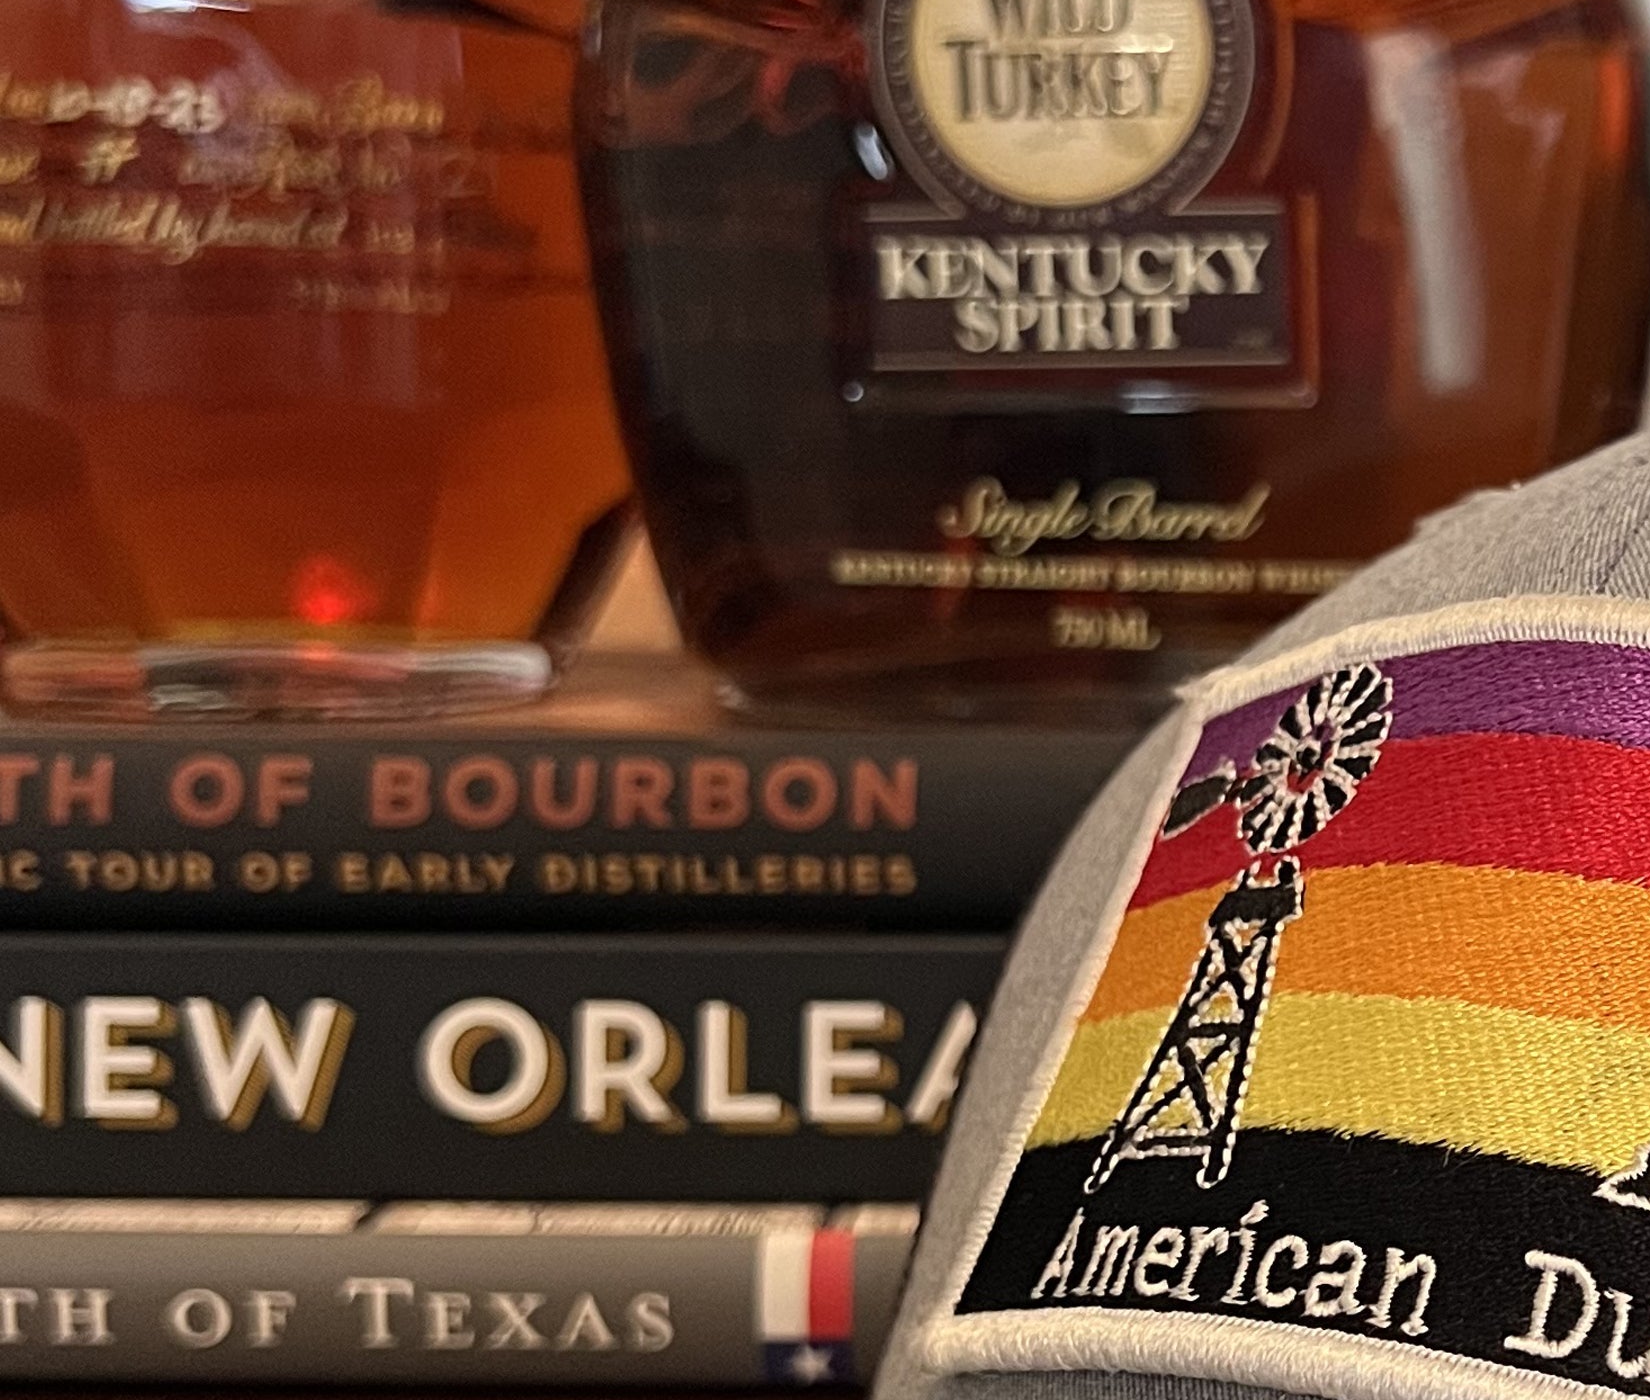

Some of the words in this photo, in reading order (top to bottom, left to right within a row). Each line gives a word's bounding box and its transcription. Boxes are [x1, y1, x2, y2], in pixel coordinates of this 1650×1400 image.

[945, 33, 1176, 122] TURKEY
[874, 232, 1270, 300] KENTUCKY
[953, 297, 1190, 352] SPIRIT
[936, 475, 1092, 556] Single
[1090, 477, 1271, 542] Barrel
[0, 753, 115, 828] TH
[168, 752, 314, 830] OF
[367, 754, 918, 831] BOURBON
[65, 850, 217, 893] TOUR
[238, 850, 313, 894] OF
[338, 852, 516, 894] EARLY
[540, 853, 918, 896] DISTILLERIES
[0, 995, 356, 1134] NEW
[1030, 1200, 1437, 1336] American
[0, 1286, 117, 1346] TH
[164, 1287, 297, 1349] OF
